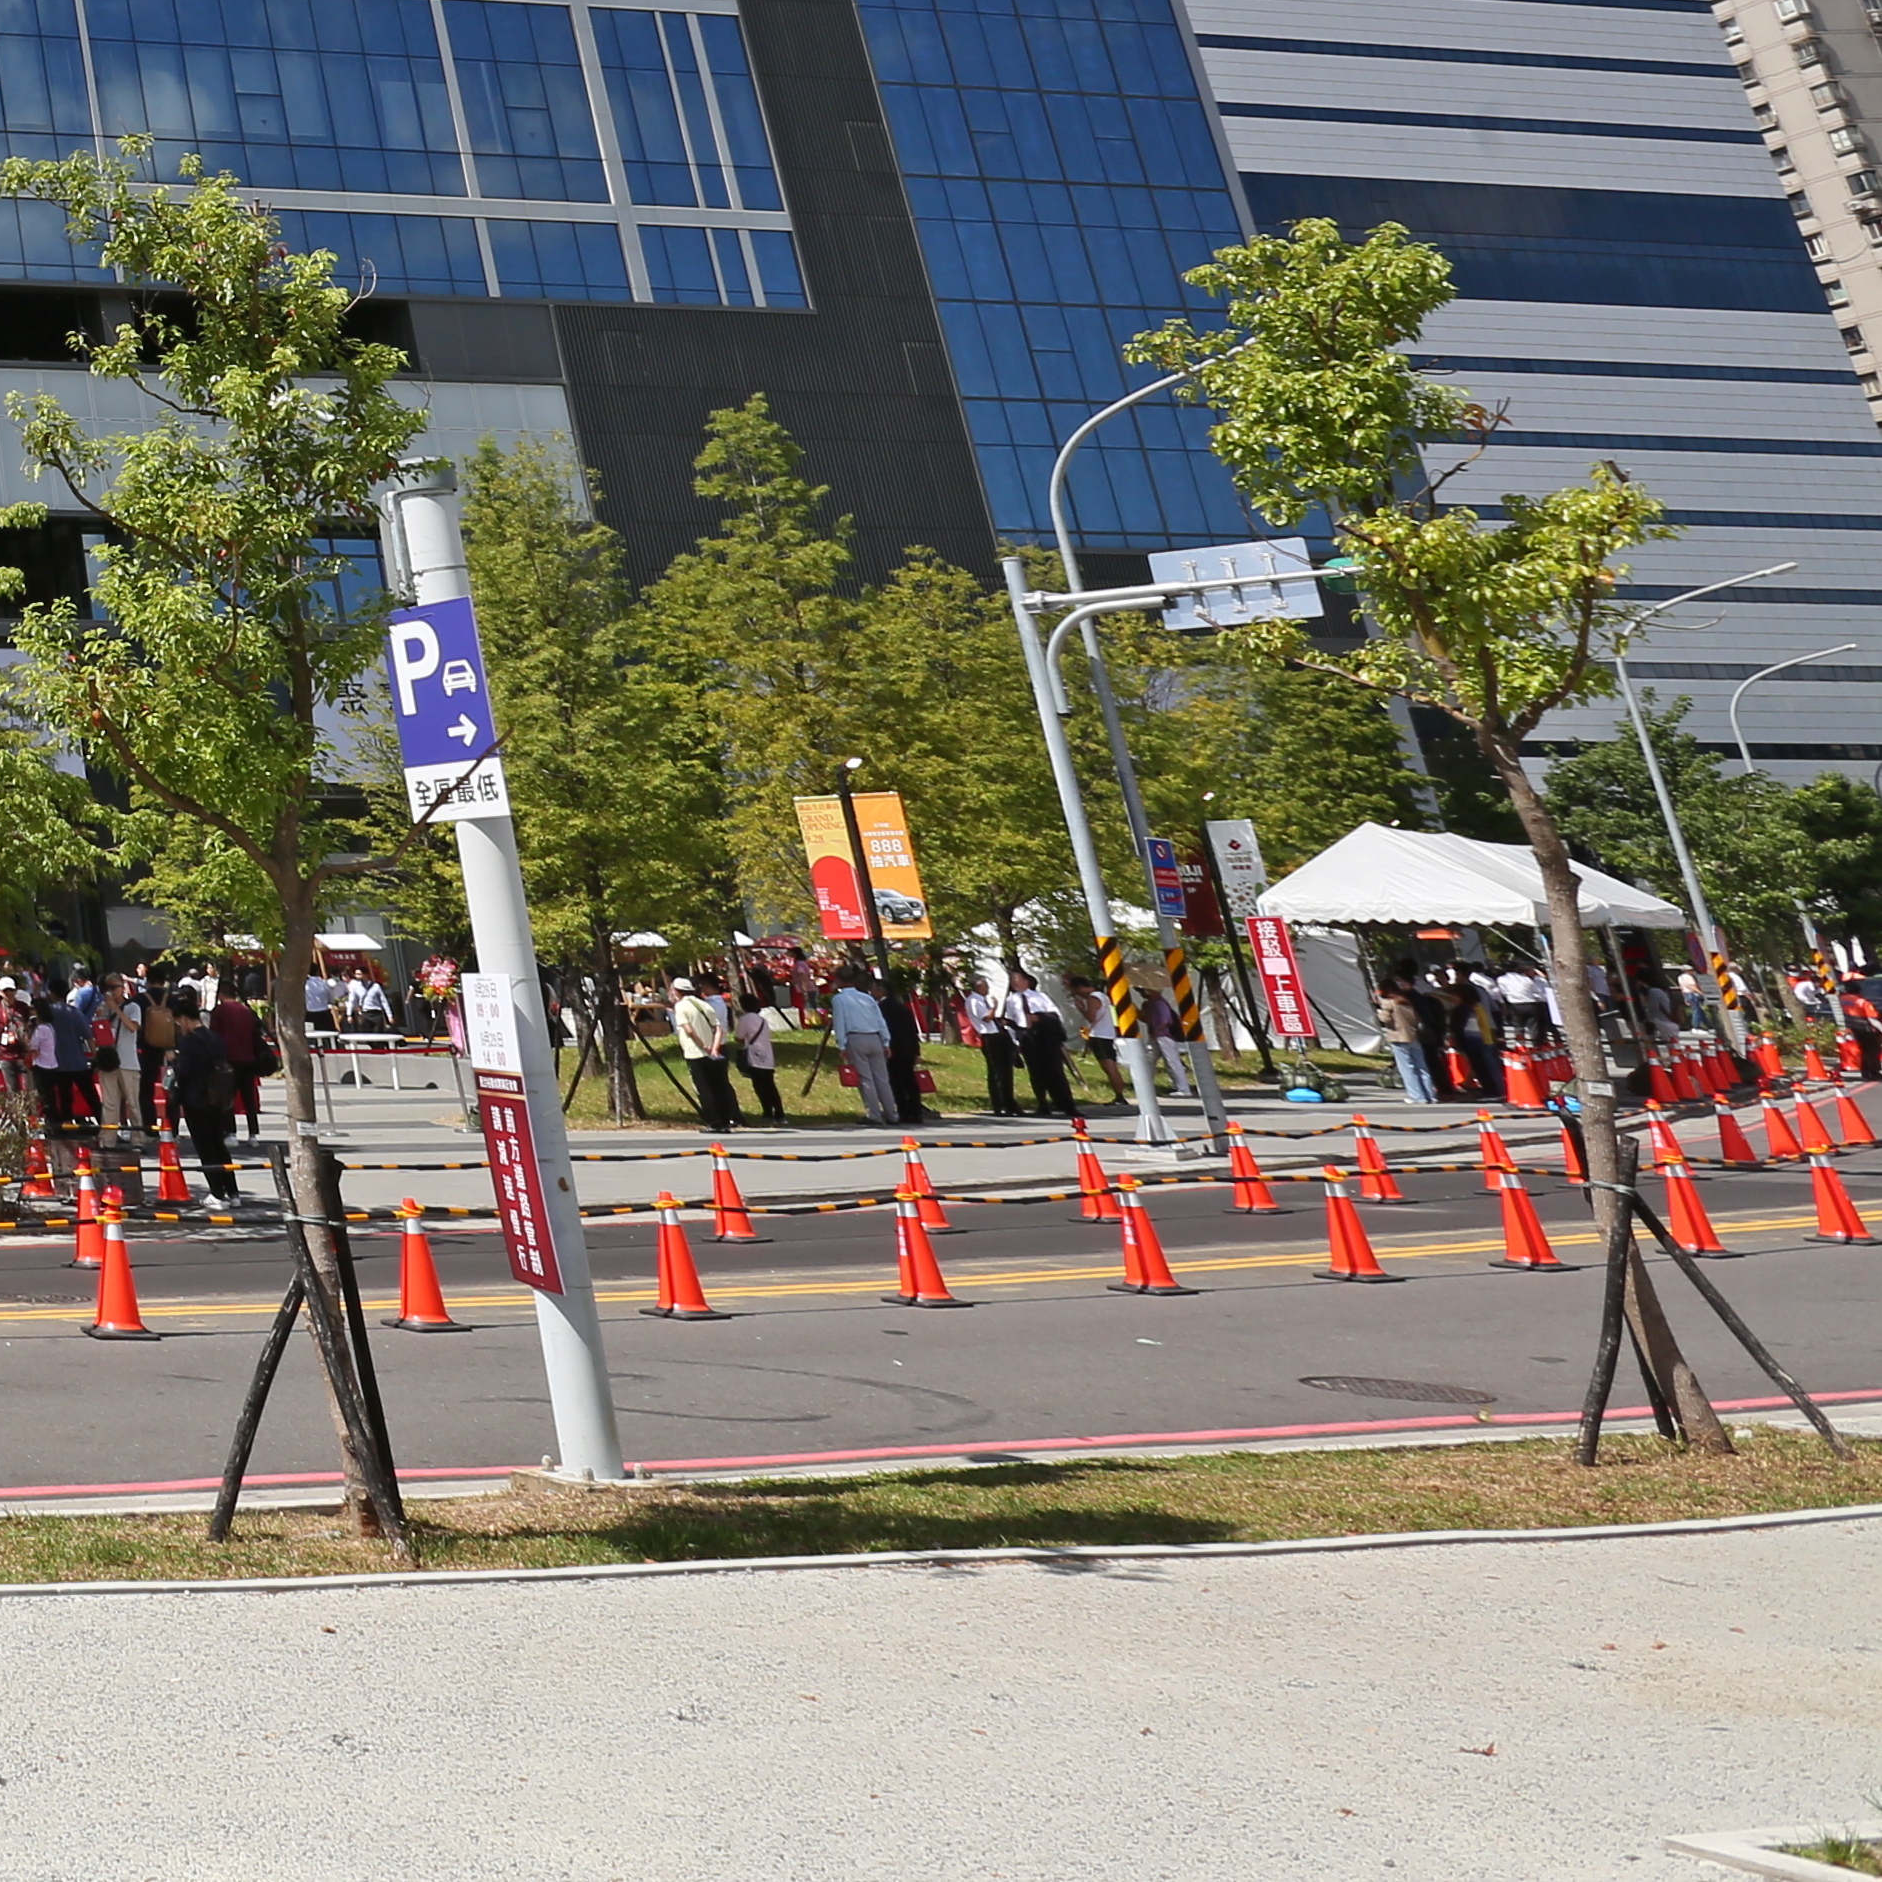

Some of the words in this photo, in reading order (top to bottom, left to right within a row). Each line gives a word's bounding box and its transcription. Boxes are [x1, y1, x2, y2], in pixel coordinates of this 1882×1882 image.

[389, 620, 441, 716] P
[869, 854, 911, 868] 抽汽車
[870, 839, 904, 853] 888
[1255, 920, 1305, 1032] 接駁上車區
